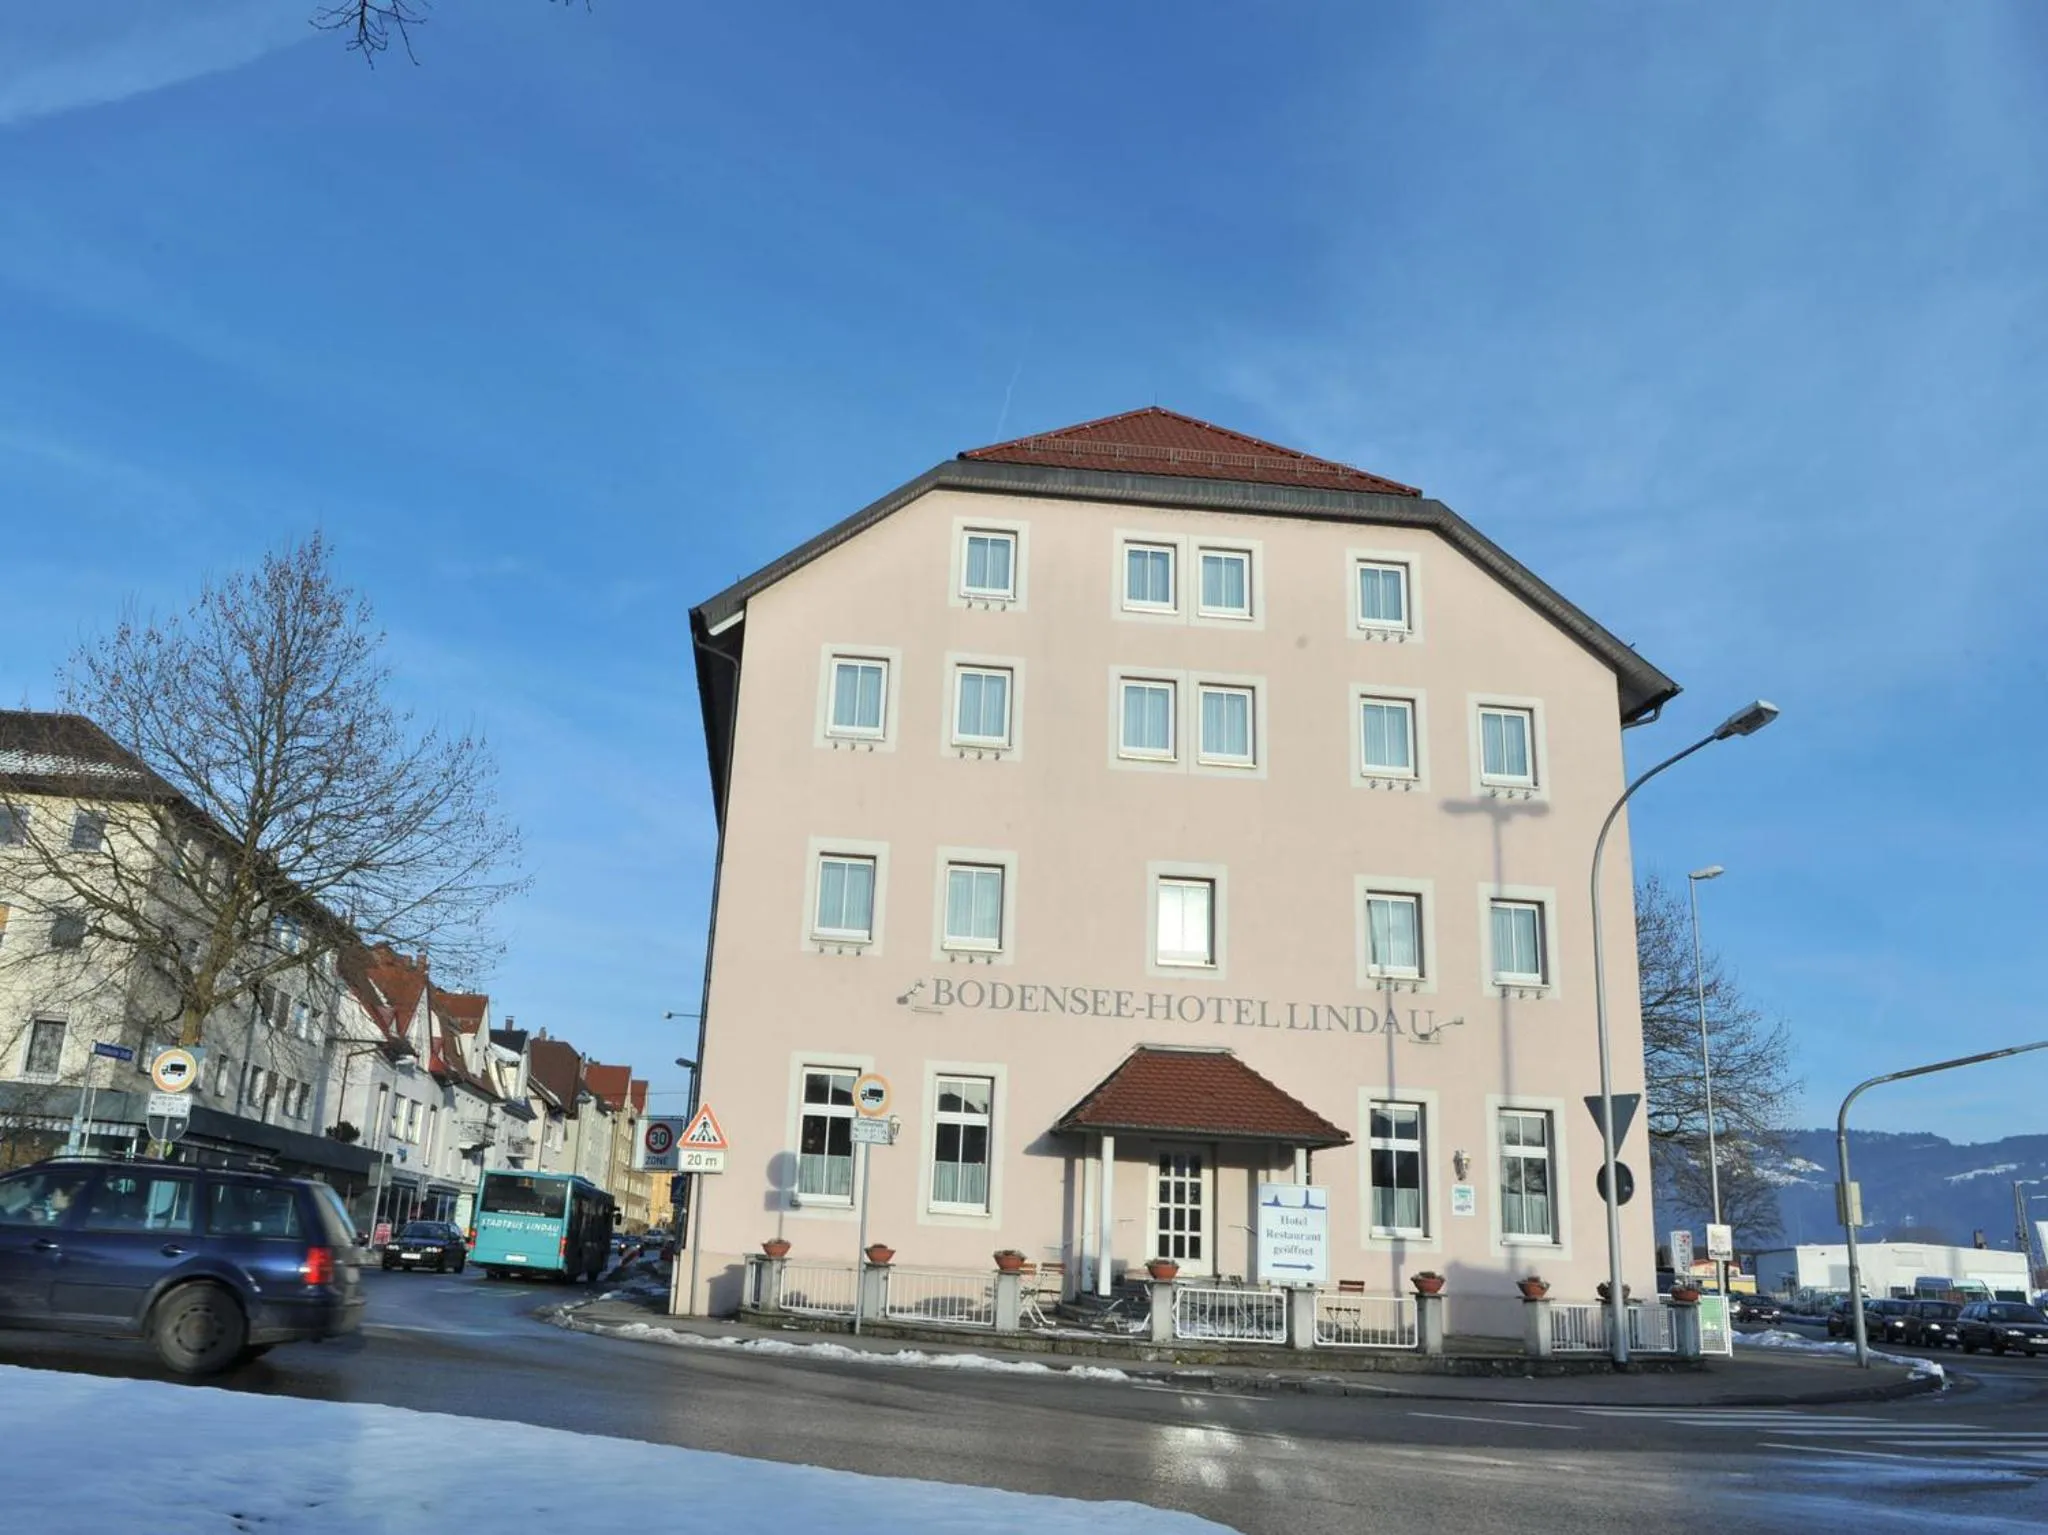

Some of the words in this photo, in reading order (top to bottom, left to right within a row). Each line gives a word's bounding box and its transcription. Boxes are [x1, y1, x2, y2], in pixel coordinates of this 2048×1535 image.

[1285, 1003, 1434, 1038] LINDAU
[651, 1131, 667, 1146] 30
[645, 1155, 669, 1166] ZONE
[687, 1154, 702, 1166] 20
[705, 1157, 717, 1167] m
[480, 1219, 524, 1231] STADTBUS
[525, 1223, 561, 1233] LINDAU
[1280, 1215, 1308, 1226] Hotel
[1266, 1228, 1321, 1242] Restaurant
[1273, 1245, 1314, 1257] geöffnet
